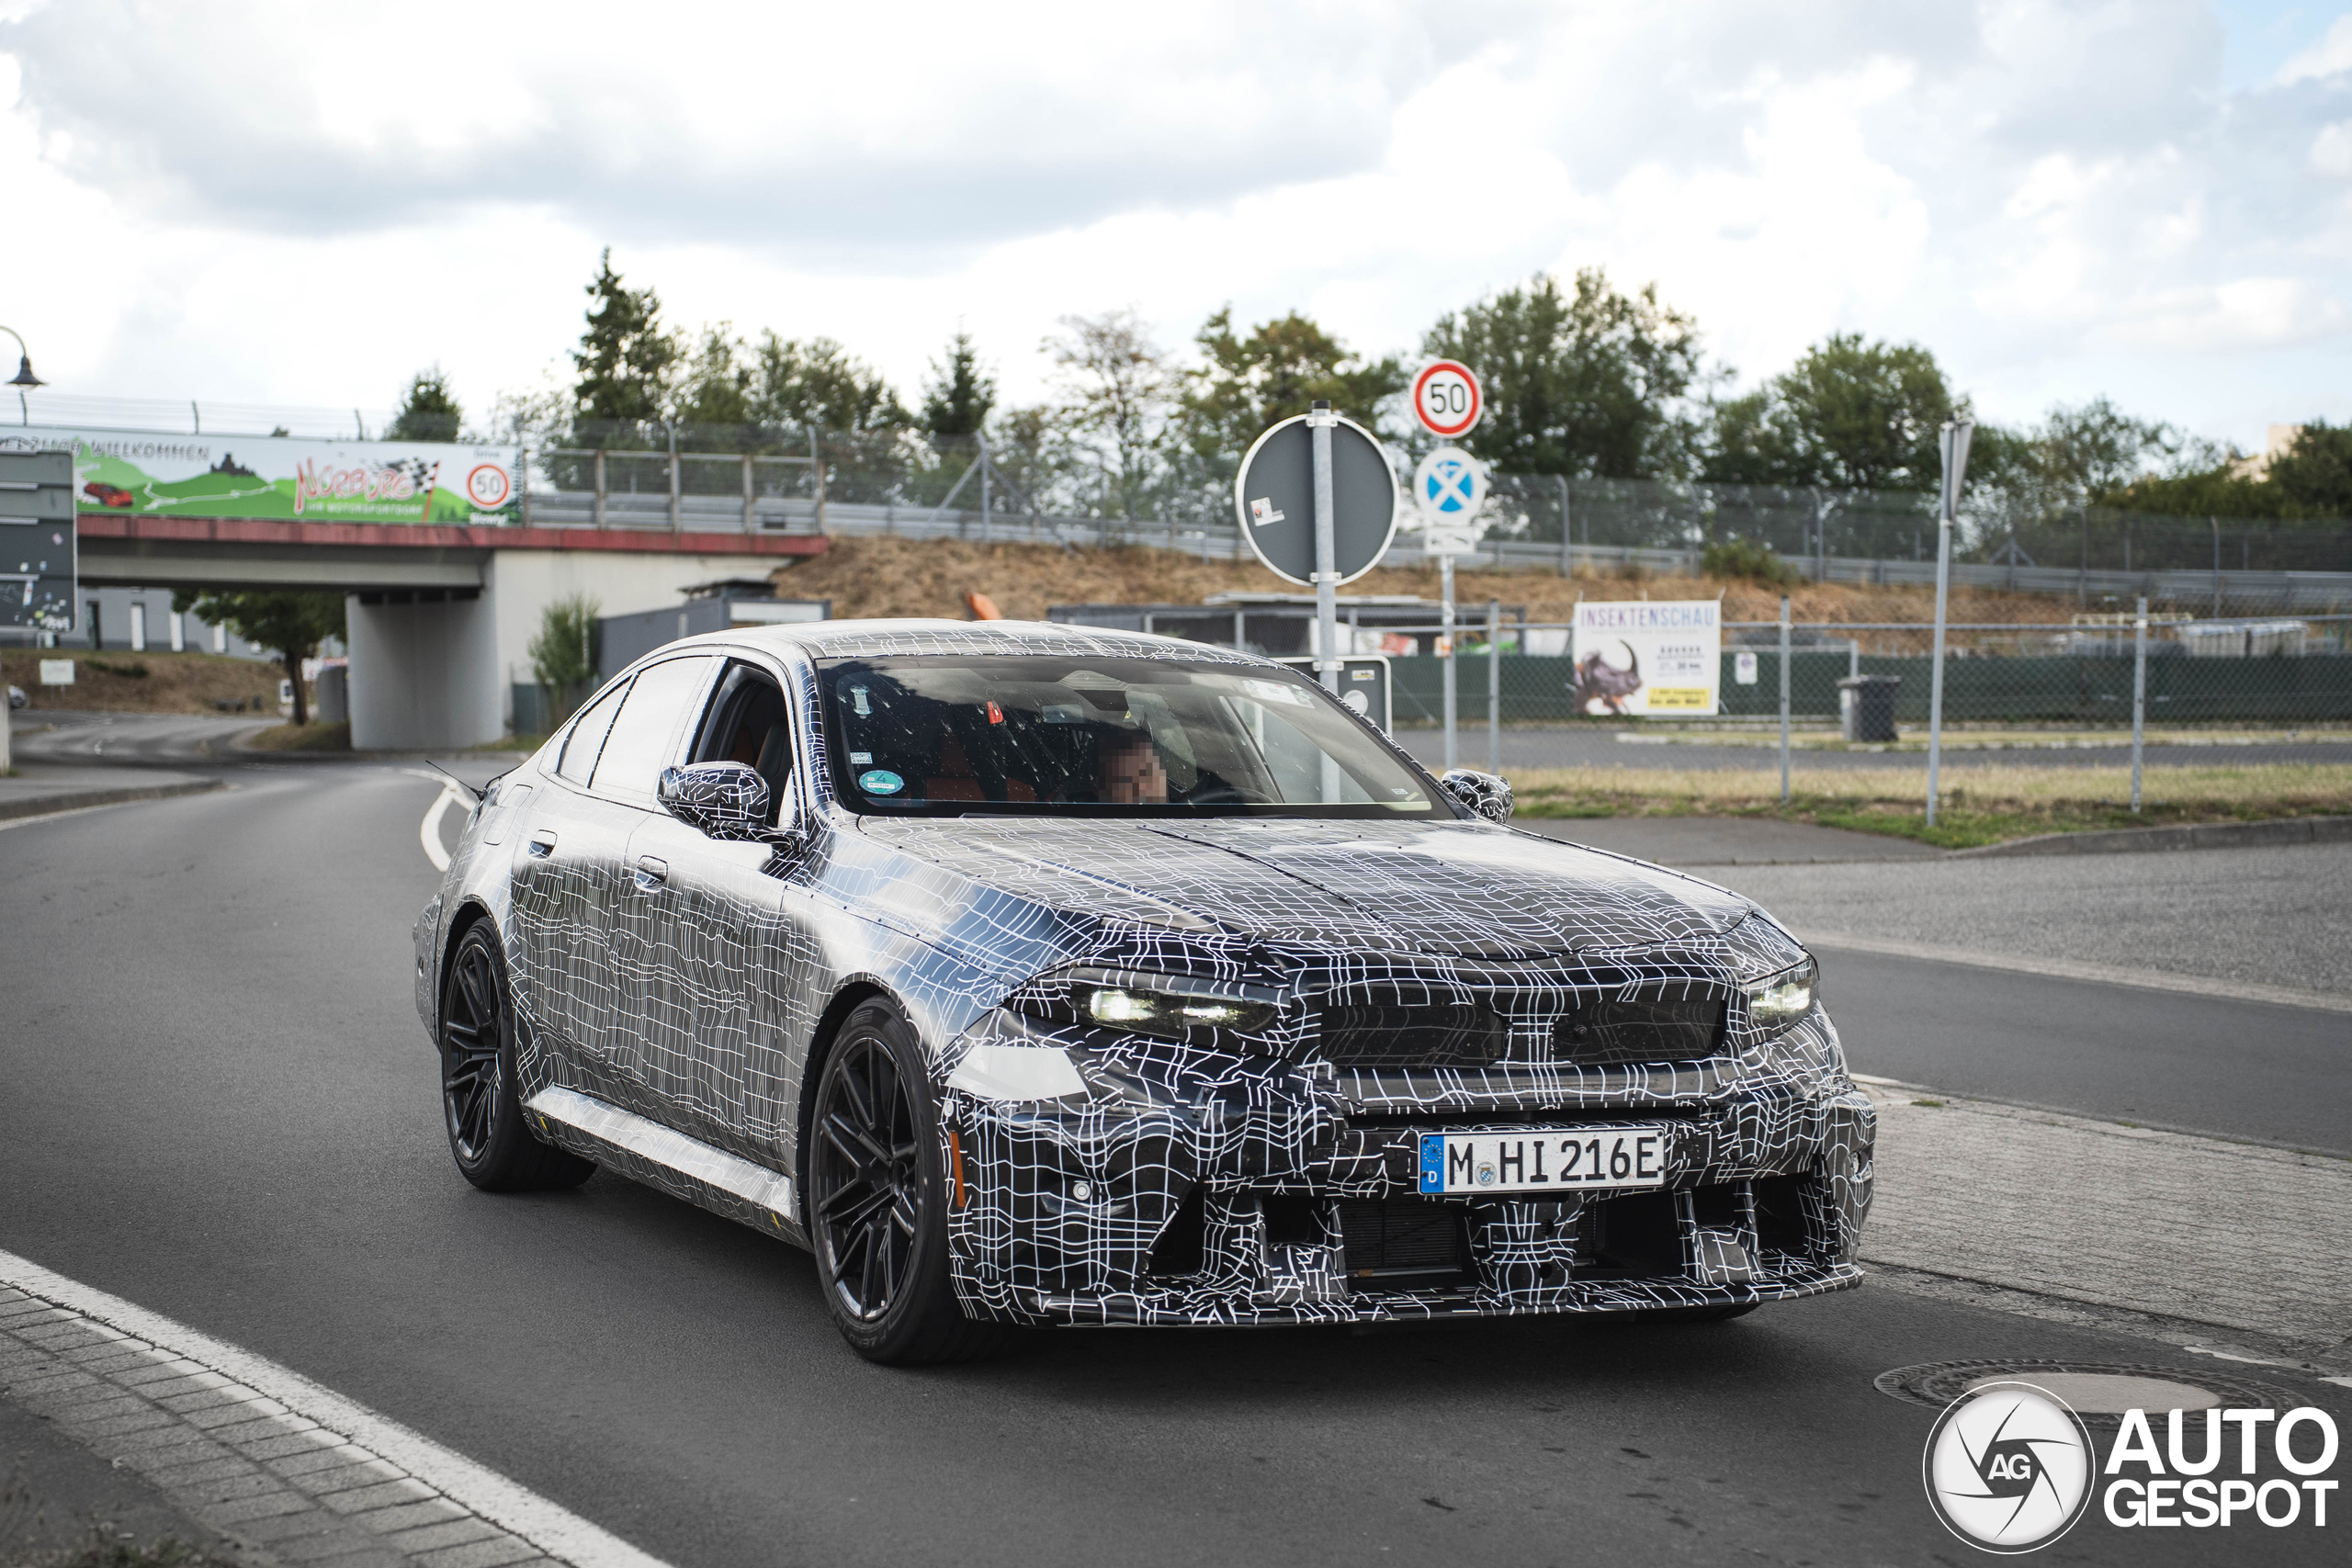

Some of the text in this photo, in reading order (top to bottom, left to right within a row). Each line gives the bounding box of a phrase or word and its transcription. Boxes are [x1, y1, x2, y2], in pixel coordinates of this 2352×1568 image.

[1430, 384, 1465, 413] 50
[0, 436, 209, 460] ERZLICH WILLKOMMEN
[476, 474, 500, 494] 50
[1581, 607, 1713, 627] INSEKTENSCHAU
[876, 774, 887, 783] 4
[1449, 1136, 1658, 1186] M HI 216E
[1428, 1170, 1437, 1183] D
